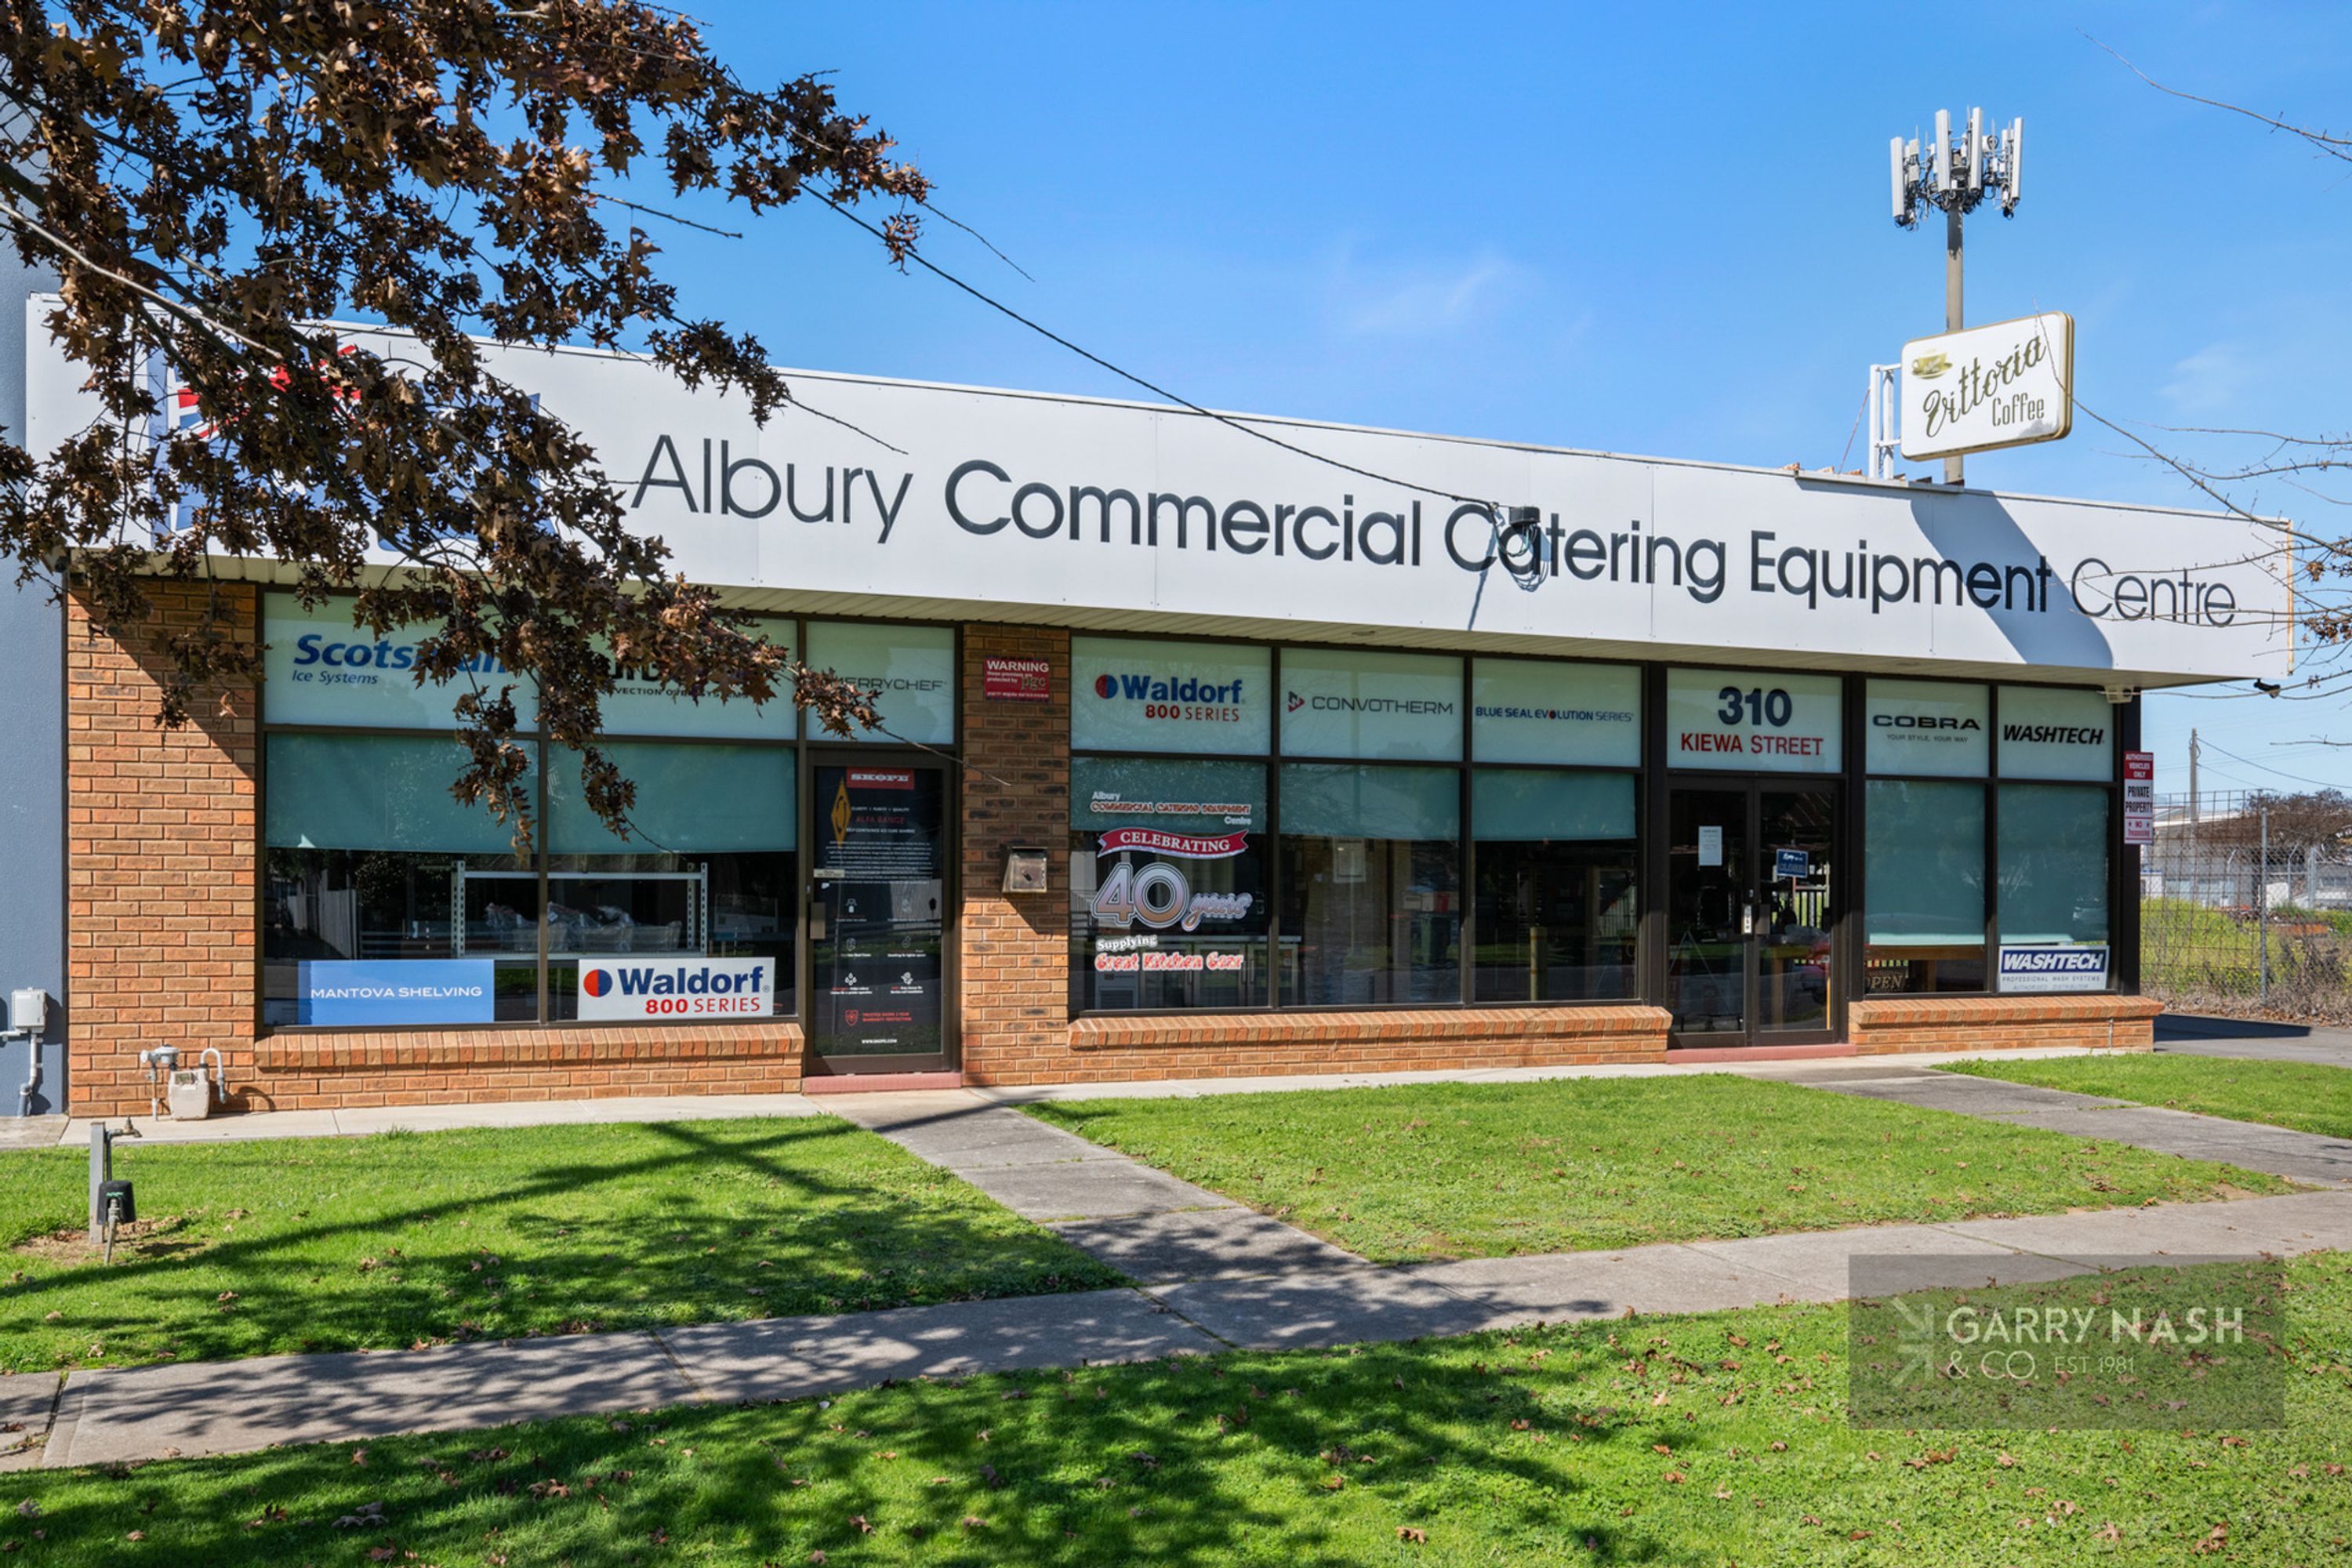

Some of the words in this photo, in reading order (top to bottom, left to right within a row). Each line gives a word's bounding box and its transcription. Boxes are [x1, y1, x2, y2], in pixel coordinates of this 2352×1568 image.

[1922, 335, 2047, 438] Vittoria
[1992, 392, 2045, 427] Coffee
[630, 434, 913, 544] Albury
[945, 459, 1421, 566] Commercial
[1444, 503, 1726, 604] Catering
[1751, 529, 2052, 614] Equipment
[2071, 557, 2237, 627] Centre
[986, 660, 1050, 673] WARNING
[292, 670, 313, 683] Ice
[318, 670, 378, 686] Systems
[1120, 674, 1243, 704] Waldorf
[1145, 704, 1180, 719] 800
[1185, 706, 1240, 722] SERIES
[1312, 696, 1454, 715] CONVOTHERM
[1475, 706, 1503, 717] BLUE
[1504, 707, 1533, 719] SEAL
[1595, 711, 1632, 722] SERIES
[1718, 686, 1793, 728] 310
[1872, 714, 1981, 730] COBRA
[2004, 724, 2104, 745] WASHTECH
[1681, 732, 1744, 753] KIEWA
[1750, 735, 1824, 756] STREET
[851, 773, 909, 782] SKOPE
[1092, 791, 1121, 801] Albury
[2127, 786, 2150, 797] PRIVATE
[1091, 801, 1155, 814] COMMERCIAL
[1156, 802, 1200, 815] CATERING
[1201, 804, 1252, 815] EQUIPMENT
[2125, 801, 2153, 813] PROPERTY
[1224, 815, 1252, 825] Centre
[1120, 831, 1231, 852] CELEBRATING
[1091, 862, 1190, 929] 40
[1095, 934, 1158, 953] Supplying
[1094, 952, 1140, 971] Great
[1142, 951, 1204, 971] Kitchen
[1206, 951, 1245, 970] Gear
[2004, 953, 2104, 971] WASHTECH
[617, 965, 764, 996] Waldorf
[310, 987, 395, 999] MANTOVA
[397, 986, 483, 997] SHELVING
[644, 998, 688, 1014] 800
[694, 997, 760, 1013] SERIES
